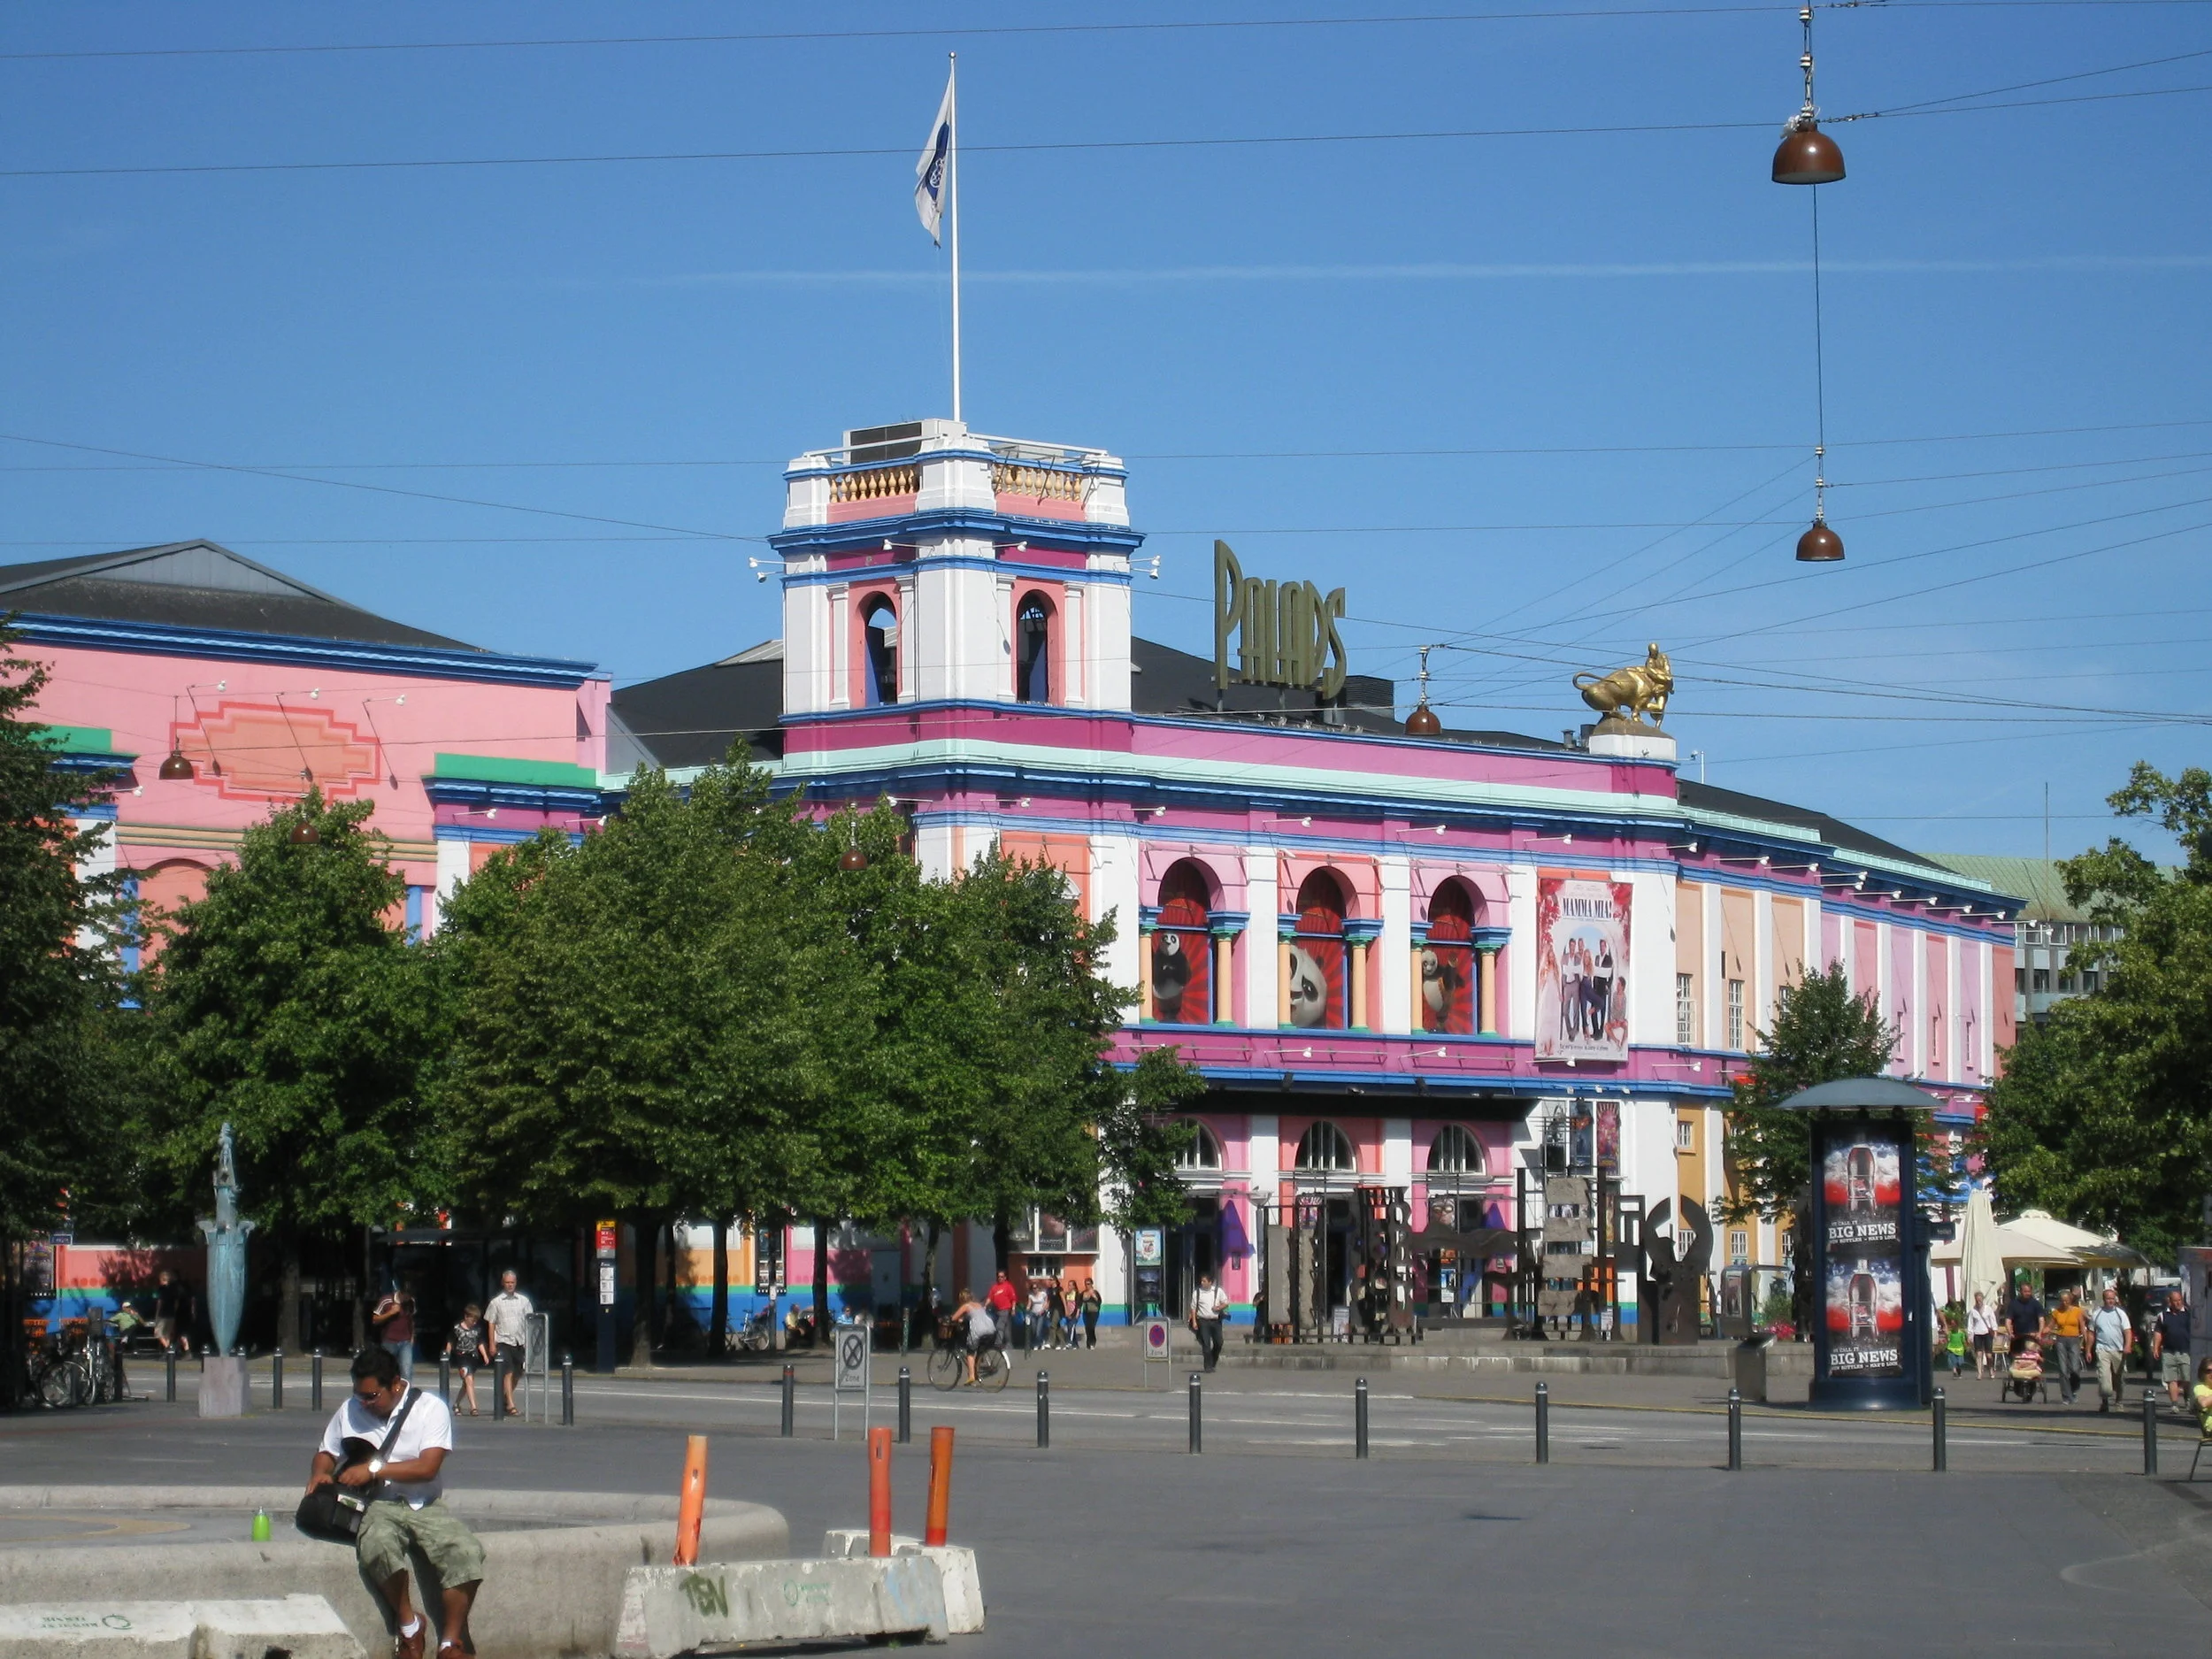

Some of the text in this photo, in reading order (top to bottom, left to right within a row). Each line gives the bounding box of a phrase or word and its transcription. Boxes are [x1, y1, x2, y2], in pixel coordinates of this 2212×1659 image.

[1214, 539, 1348, 701] PALADS
[1563, 897, 1612, 918] MAMMA MIA!
[1828, 1223, 1896, 1240] BIG NEWS
[1830, 1349, 1898, 1365] BIG NEWS
